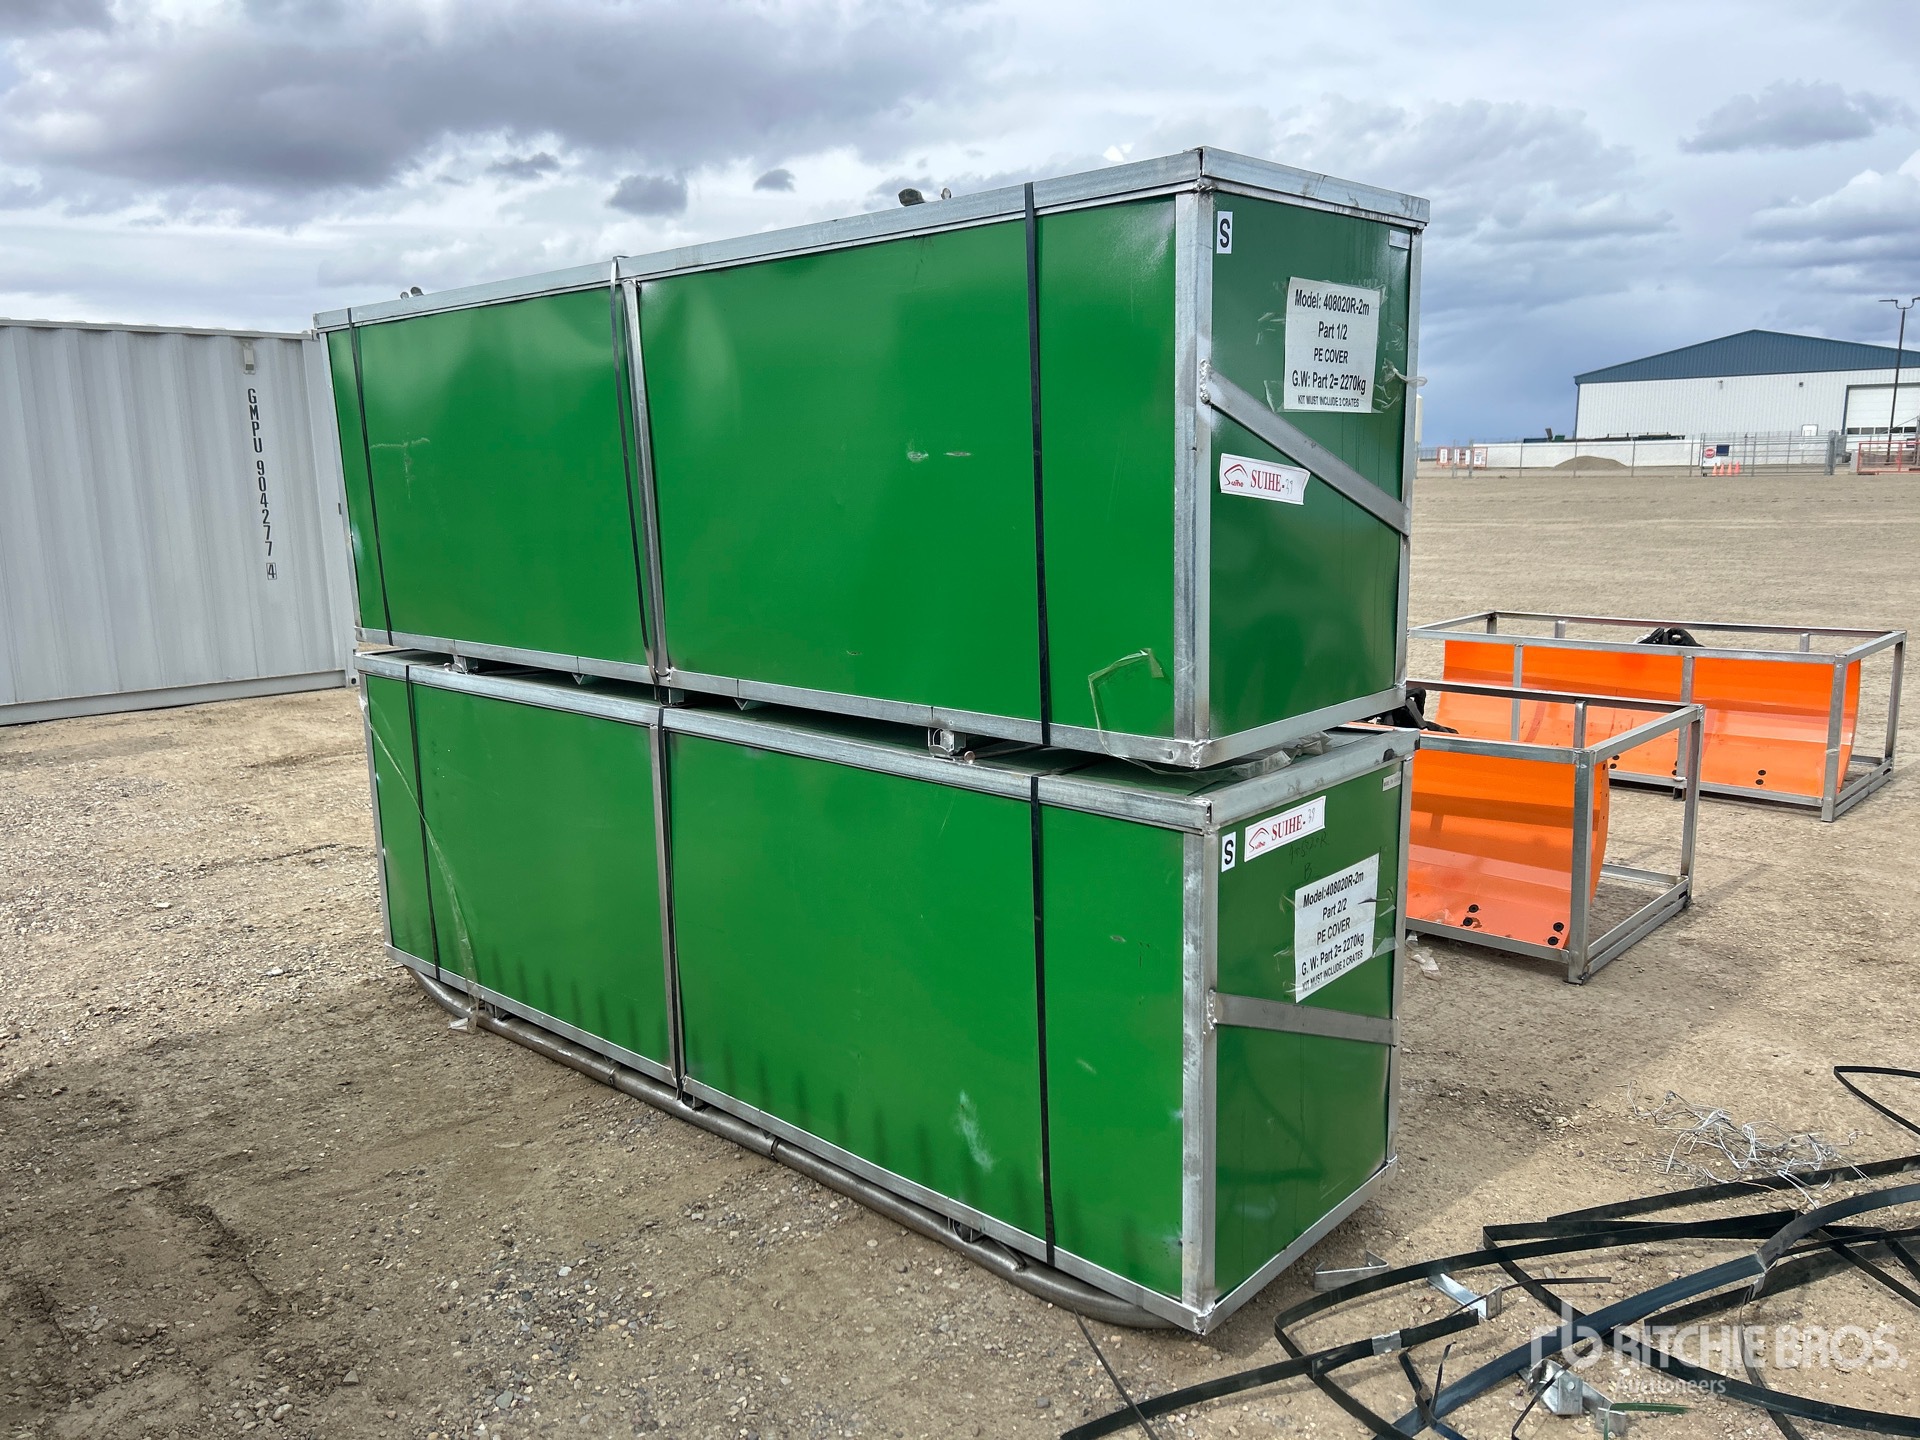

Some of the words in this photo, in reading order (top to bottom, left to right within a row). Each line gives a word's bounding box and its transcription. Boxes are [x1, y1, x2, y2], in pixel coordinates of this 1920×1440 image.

[1220, 218, 1230, 248] S
[1294, 289, 1321, 309] Model:
[1323, 293, 1369, 316] 408020R-2m
[1318, 321, 1334, 339] Part
[1336, 323, 1347, 340] 1/2
[1313, 347, 1323, 362] PE
[1324, 349, 1348, 364] COVER
[1292, 369, 1311, 387] G.W:
[1312, 371, 1328, 389] Part
[1340, 374, 1366, 395] 2270kg
[1306, 395, 1318, 405] MUST
[1320, 396, 1338, 406] INCLUDE
[1343, 397, 1359, 407] CRATES
[247, 388, 263, 453] GMPU
[256, 460, 273, 556] 904277
[267, 563, 276, 580] 4
[1225, 840, 1234, 865] S
[1322, 904, 1336, 920] Part
[1337, 898, 1347, 914] 2/2
[1316, 929, 1326, 945] PE
[1327, 917, 1350, 939] COVER
[1320, 948, 1333, 965] Part
[1343, 933, 1365, 953] 2270kg
[1323, 960, 1342, 979] INCLUDE
[1346, 949, 1363, 966] CRATES
